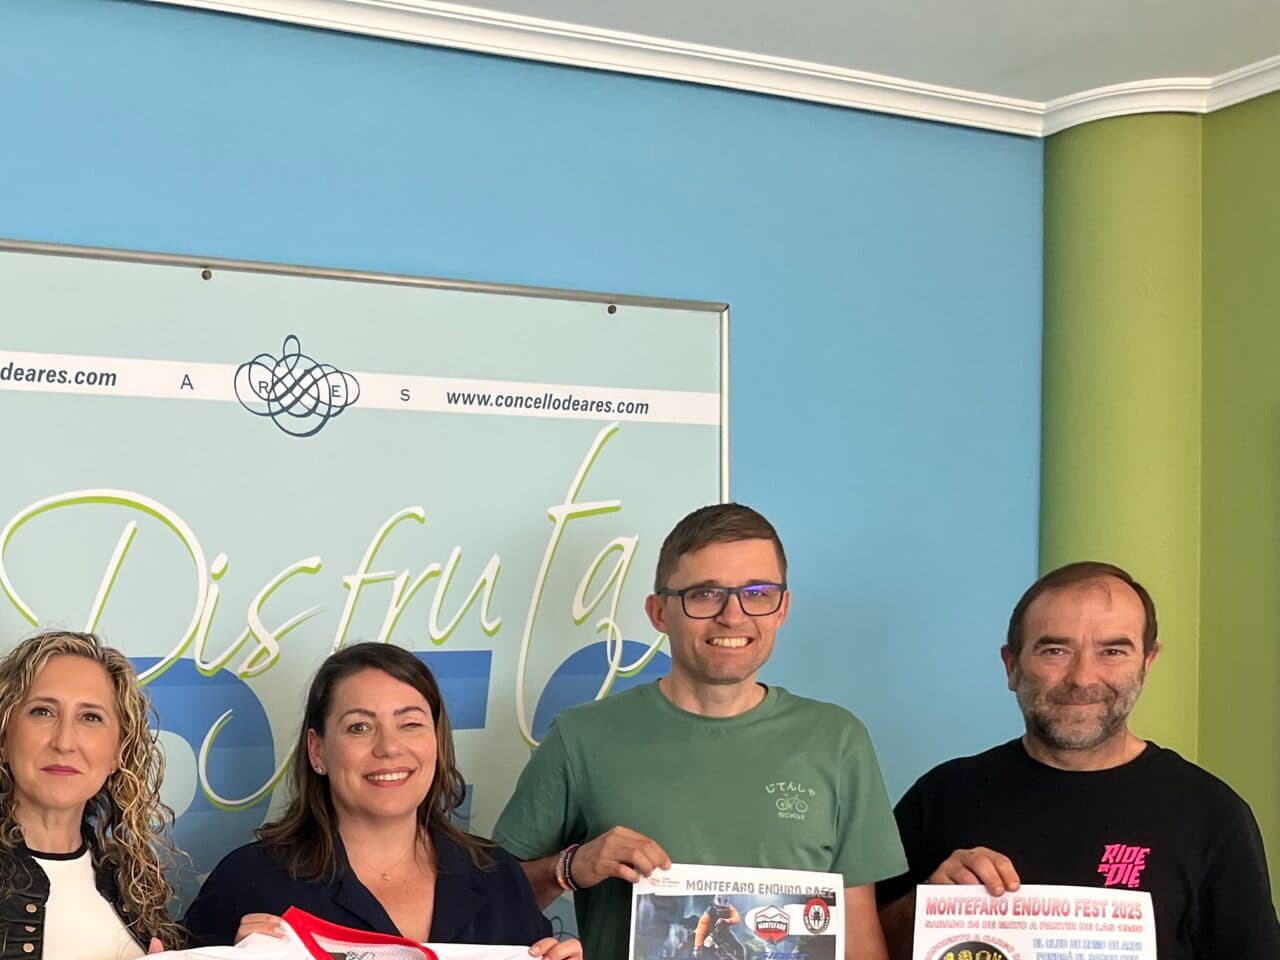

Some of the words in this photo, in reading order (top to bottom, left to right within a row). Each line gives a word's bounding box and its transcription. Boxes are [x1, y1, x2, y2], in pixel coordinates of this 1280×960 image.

[446, 387, 650, 415] www.concellodeares.com
[1101, 843, 1151, 865] RIDE
[686, 880, 755, 894] MONTEFARO
[758, 884, 801, 896] ENDURO
[926, 896, 1008, 916] MONTEFARO
[1012, 897, 1070, 917] ENDURO
[1074, 899, 1107, 918] FEST
[1112, 902, 1143, 920] 2025
